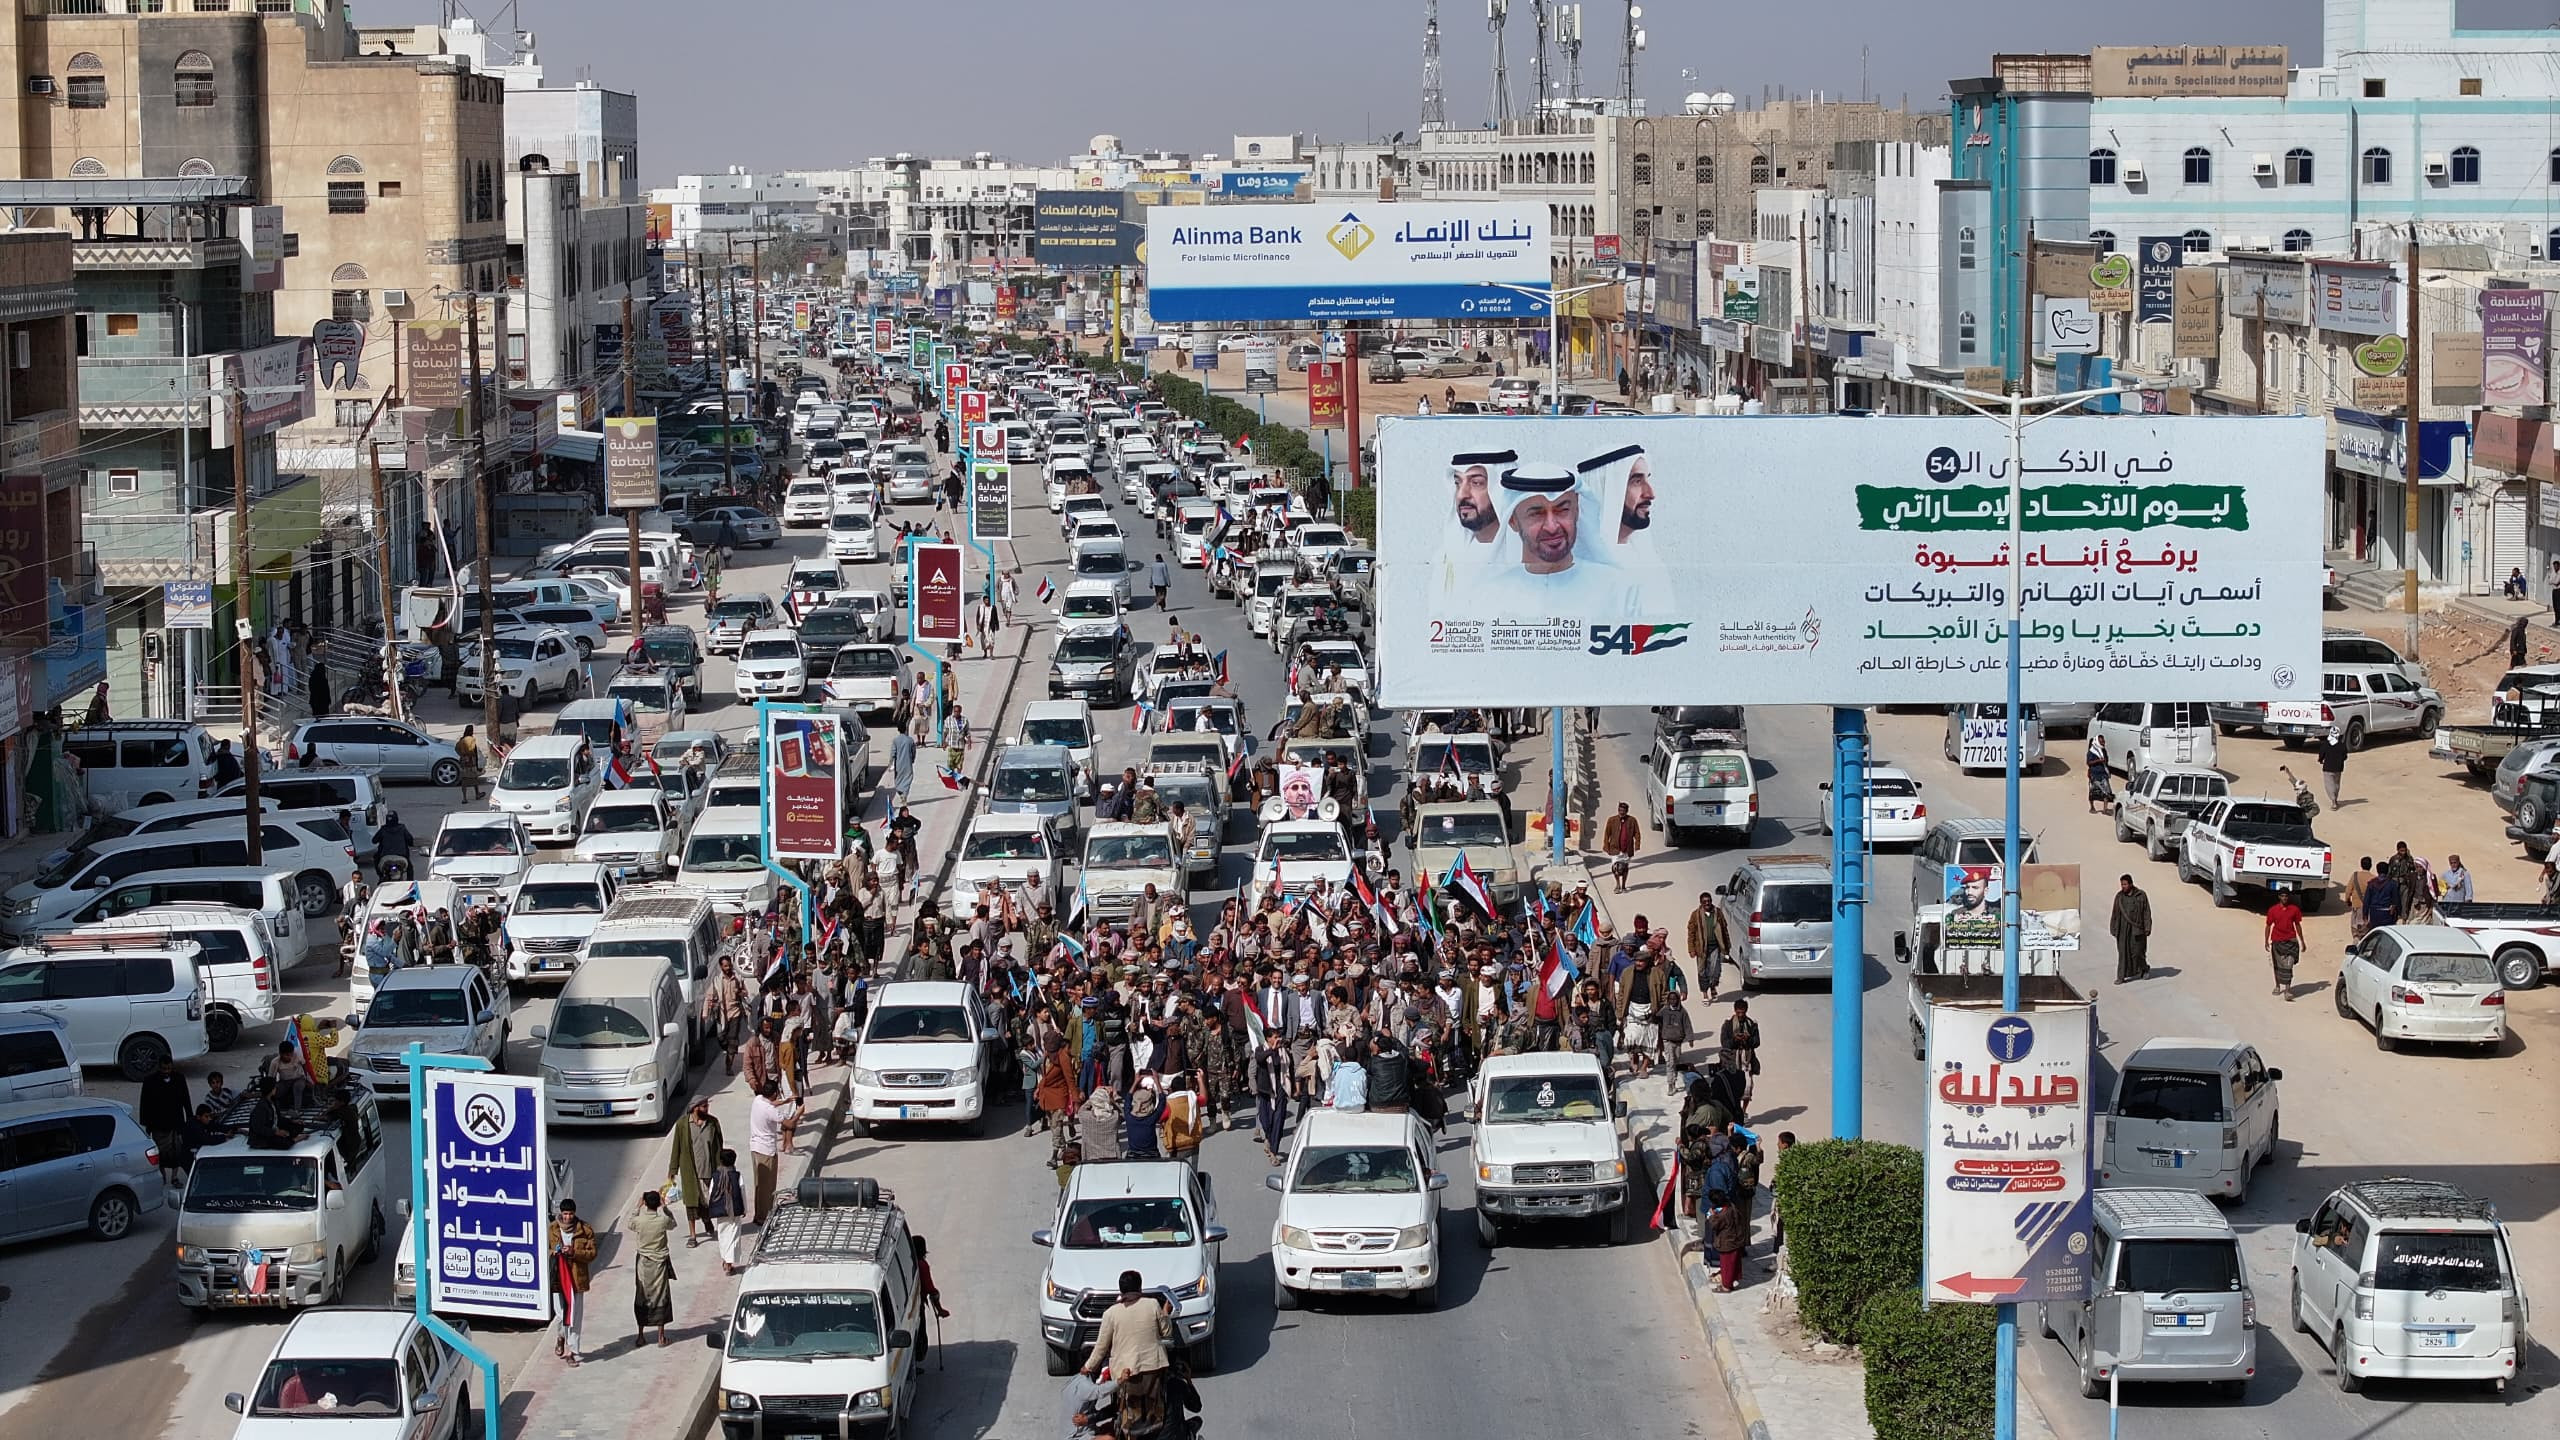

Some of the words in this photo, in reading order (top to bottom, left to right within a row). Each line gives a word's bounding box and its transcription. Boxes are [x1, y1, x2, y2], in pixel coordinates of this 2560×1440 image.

[2126, 46, 2188, 74] التخصصي
[2191, 47, 2227, 67] الشفاء
[2230, 48, 2284, 69] مستشفى
[2127, 75, 2138, 86] Al
[2141, 75, 2168, 86] shifa
[2174, 75, 2236, 88] Specialized
[2239, 75, 2284, 88] Hospital
[1079, 204, 1119, 218] بطاريات
[1172, 228, 1243, 246] Alinma
[1250, 226, 1303, 245] Bank
[1395, 219, 1470, 248] الإنماء
[1477, 219, 1533, 247] بنك
[1181, 253, 1197, 263] For
[1199, 253, 1231, 263] Islamic
[1233, 252, 1291, 263] Microfinance
[1410, 250, 1453, 263] الإسلامي
[1454, 250, 1484, 263] الأصغر
[1486, 249, 1518, 262] للتمويل
[2143, 264, 2173, 276] يدلية
[1307, 297, 1336, 307] مستدام
[1336, 296, 1364, 306] مستقبل
[2107, 291, 2130, 300] صيدلية
[2180, 305, 2210, 316] عيادات
[2520, 312, 2542, 323] لطب
[2176, 332, 2214, 345] التخصصية
[411, 341, 457, 355] صيدلية
[412, 357, 457, 371] اليمامة
[1312, 380, 1341, 397] البرج
[2390, 379, 2405, 390] صيدلية
[1313, 401, 1342, 418] ماركت
[609, 438, 654, 453] صيدلية
[610, 455, 655, 469] اليمامة
[1364, 454, 1375, 464] 50
[1929, 457, 1957, 473] 54
[1989, 450, 2107, 480] الذكى
[2114, 450, 2174, 484] في
[611, 479, 655, 488] والمستلزمات
[977, 482, 1007, 494] صيدلية
[978, 494, 1007, 505] اليمامة
[2026, 493, 2137, 518] الاتحاد
[1882, 493, 2012, 530] لإماراتي
[2144, 493, 2231, 524] ليوم
[1913, 542, 2012, 574] شبوة
[2025, 540, 2109, 574] أبناء
[1864, 581, 2005, 609] والتبريكات
[2019, 581, 2106, 613] التهاني
[2111, 580, 2175, 602] آيات
[2179, 578, 2262, 604] أسمى
[1445, 620, 1472, 628] National
[1473, 620, 1485, 629] Day
[1491, 617, 1561, 627] الاتحاد
[1562, 617, 1582, 629] روح
[1719, 620, 1764, 632] الأصالة
[1765, 622, 1797, 633] شبوة
[1430, 620, 1444, 643] 2
[1491, 629, 1520, 638] SPIRIT
[1521, 629, 1532, 638] OF
[1534, 629, 1551, 638] THE
[1553, 629, 1581, 638] UNION
[1863, 617, 1979, 644] الأمجاد
[2070, 618, 2101, 644] يا
[1445, 635, 1483, 643] DECEMBER
[1588, 624, 1635, 656] 54
[1719, 633, 1753, 641] Shabwah
[1753, 633, 1797, 642] Authenticity
[1856, 655, 1912, 674] العالم.
[1968, 654, 2002, 673] على
[2208, 655, 2262, 673] ودامت
[1964, 720, 1995, 744] للإعلان
[2256, 856, 2311, 869] TOYOTA
[1938, 1060, 2080, 1114] صيدلية
[1942, 1123, 2020, 1151] العشلة
[2027, 1122, 2076, 1151] أحمد
[441, 1141, 533, 1174] النبيل
[1959, 1161, 1999, 1175] طبية
[2001, 1162, 2055, 1175] مستلزمات
[1970, 1178, 2000, 1191] مستحضرات
[2011, 1179, 2032, 1191] أطفال
[2031, 1179, 2060, 1189] مستلزمات
[441, 1178, 534, 1207] لمواد
[443, 1216, 534, 1247] البناء
[446, 1251, 469, 1263] أدوات
[476, 1254, 500, 1266] أدوات
[508, 1255, 530, 1267] مواد
[445, 1262, 469, 1274] سباكة
[476, 1265, 500, 1277] كهرباء
[510, 1268, 531, 1280] بناء
[2045, 1267, 2079, 1276] 05203027
[752, 1294, 770, 1305] الله
[770, 1295, 801, 1307] تبارك
[803, 1295, 822, 1305] الله
[821, 1294, 853, 1306] ماشاء
[2425, 1338, 2443, 1346] 2829
